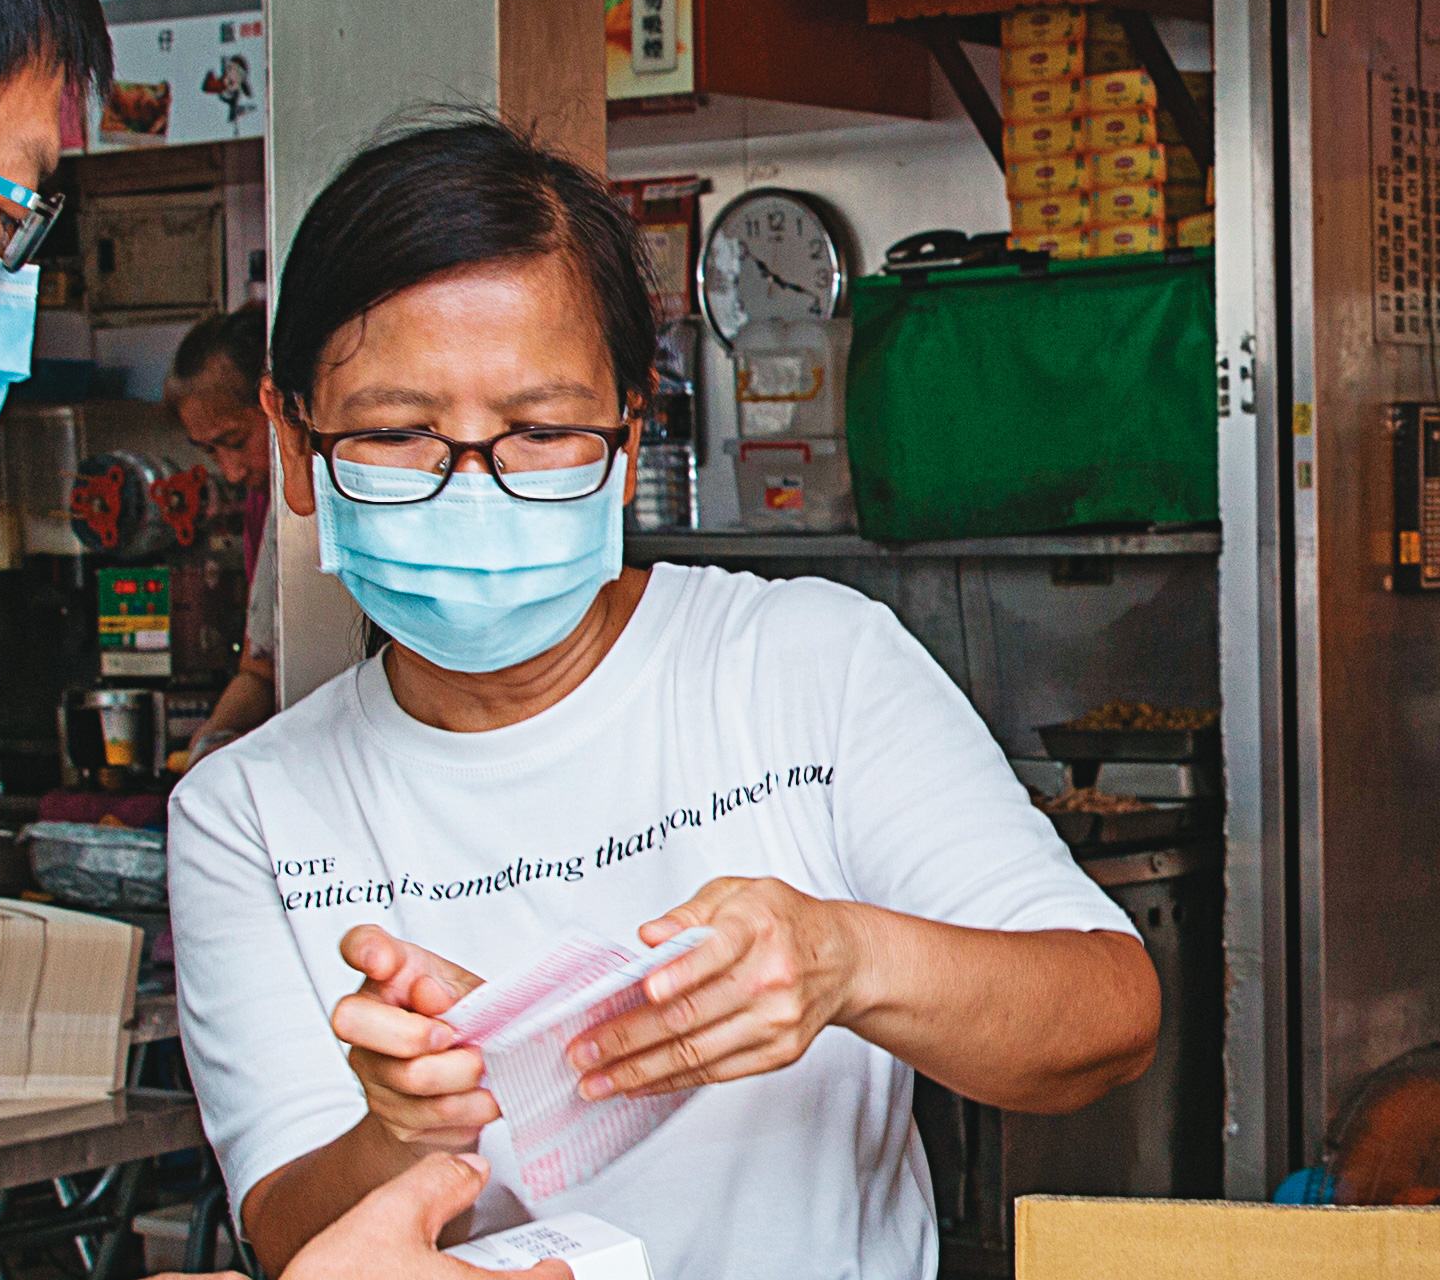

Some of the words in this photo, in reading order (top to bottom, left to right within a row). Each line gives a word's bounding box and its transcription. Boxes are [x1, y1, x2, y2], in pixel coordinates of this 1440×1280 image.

[400, 873, 424, 896] is
[429, 856, 585, 900] something
[595, 825, 655, 868] that
[659, 808, 702, 850] you
